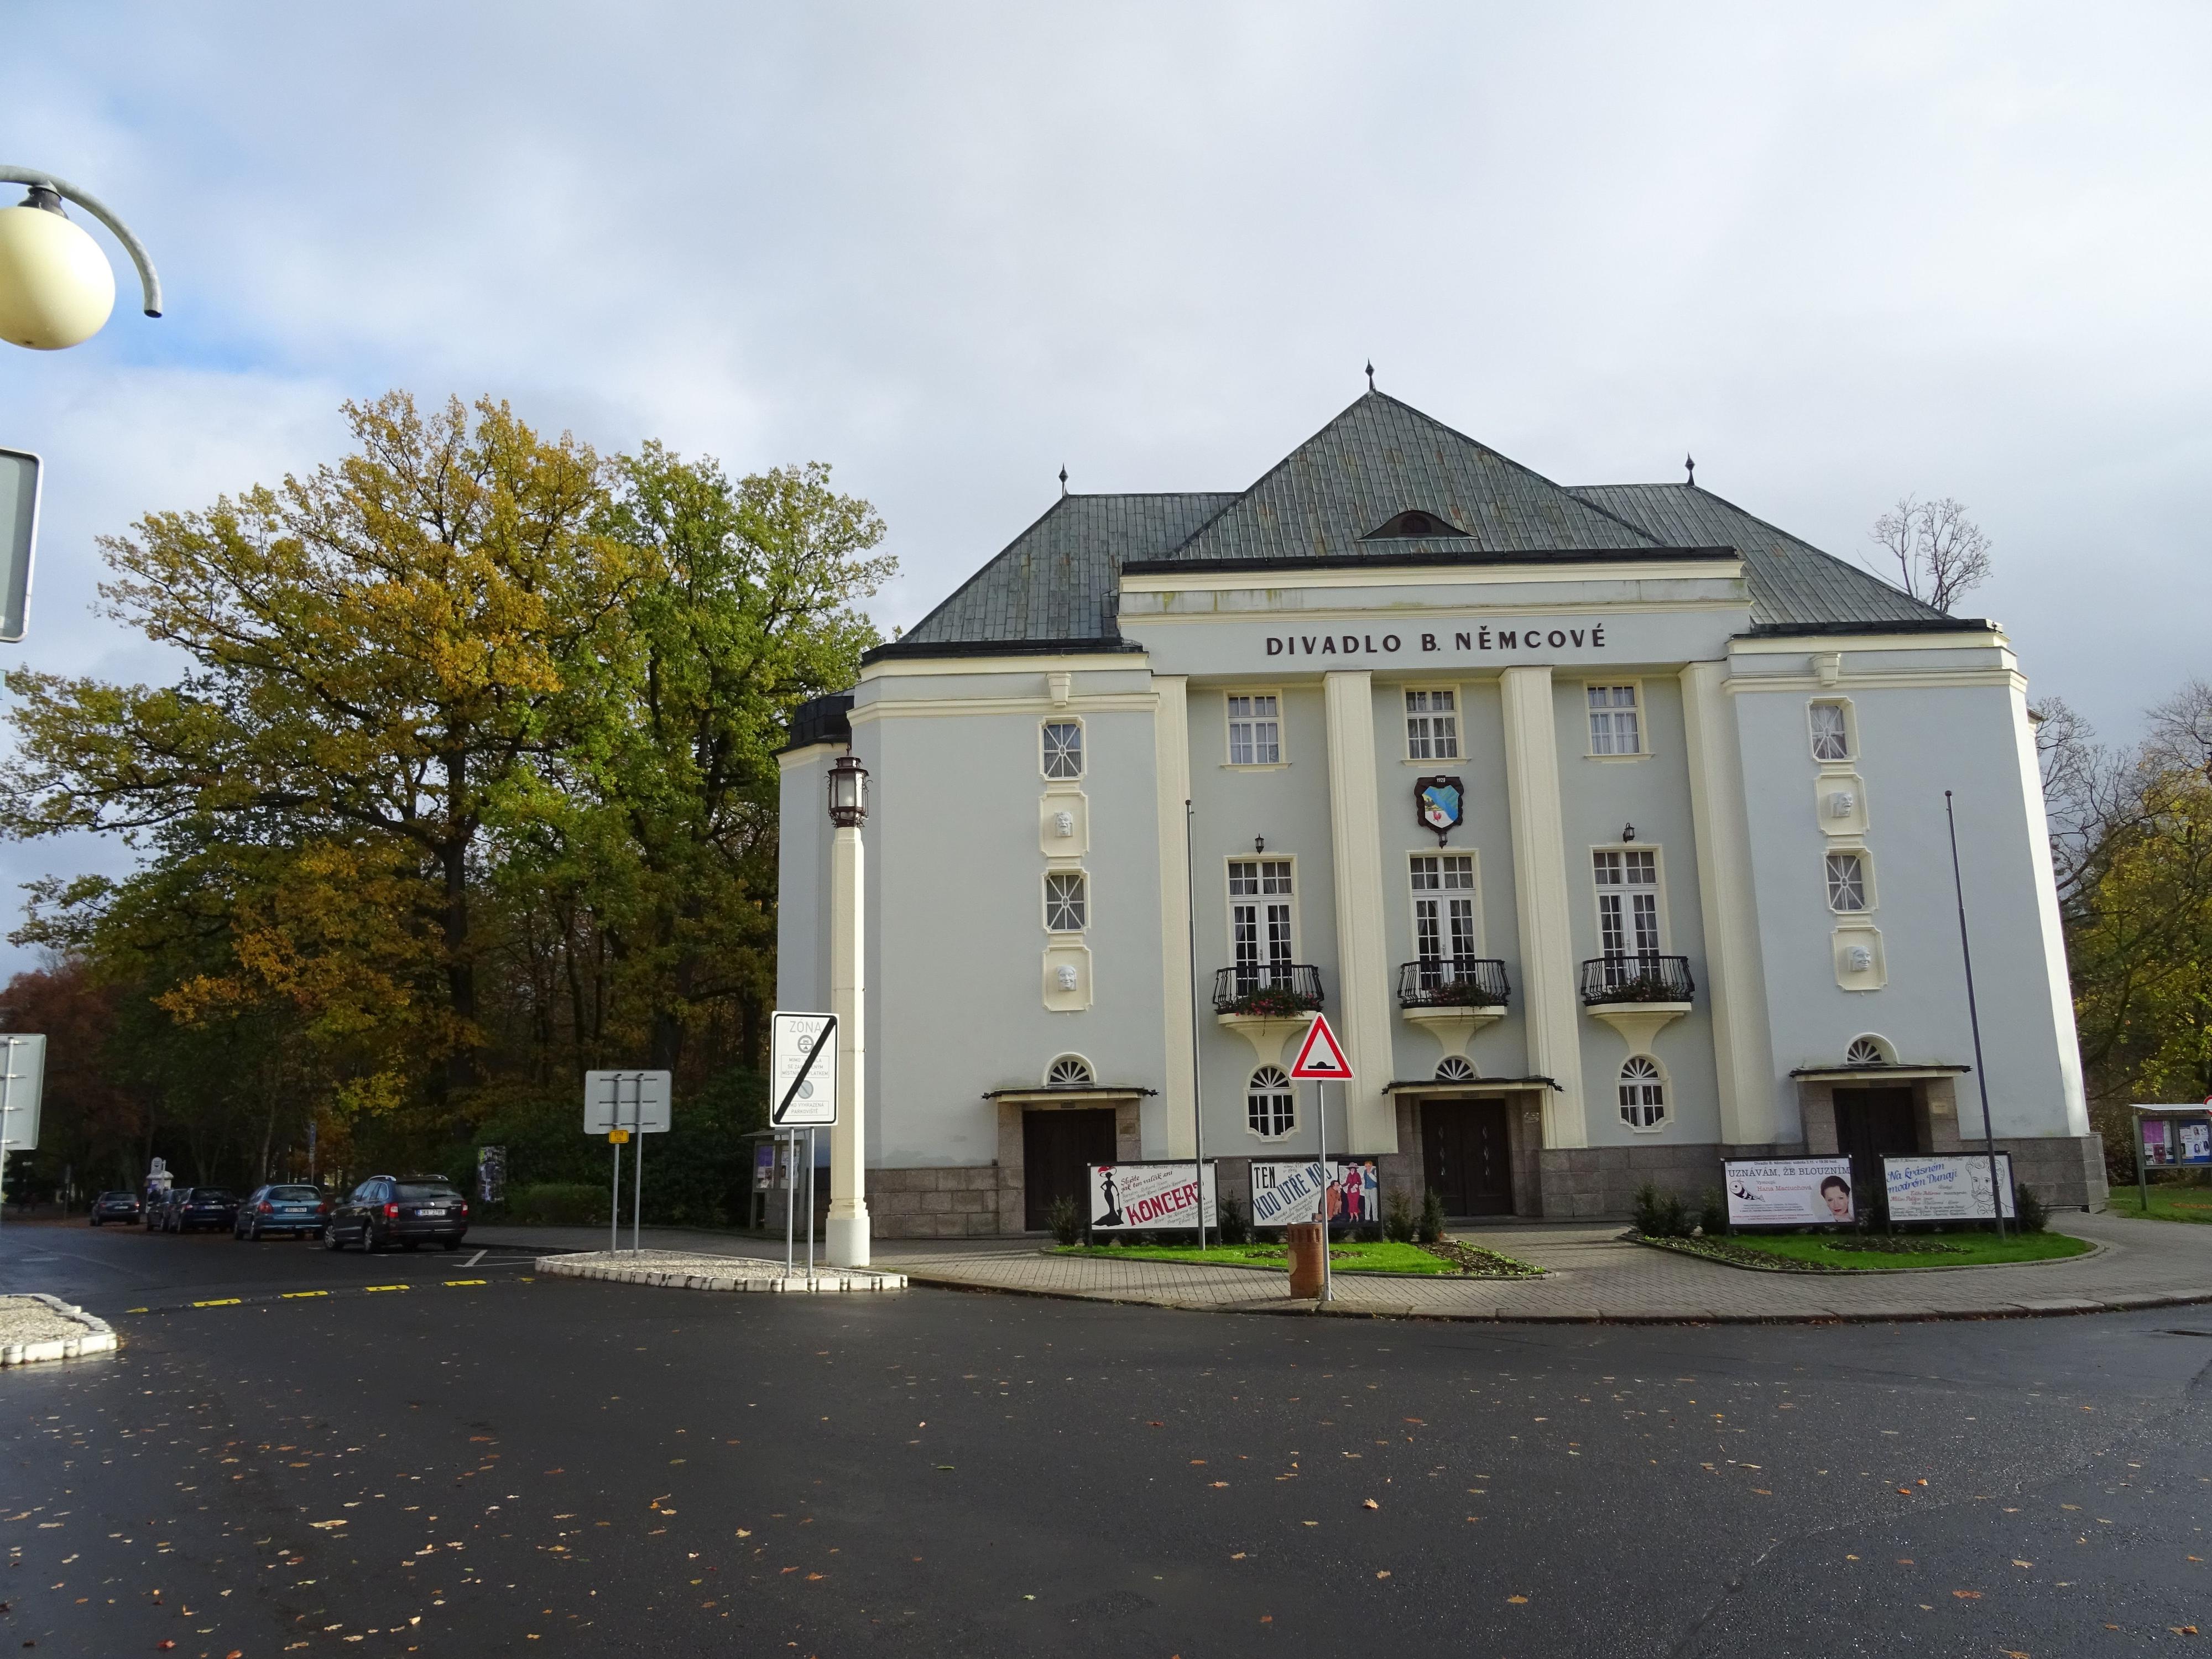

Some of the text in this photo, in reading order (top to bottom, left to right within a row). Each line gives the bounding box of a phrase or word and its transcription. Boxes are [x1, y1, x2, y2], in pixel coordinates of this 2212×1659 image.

[1266, 623, 1606, 655] DIVADLO B. NĚMCOVÉ
[789, 1019, 821, 1032] ZÓNA
[1121, 1175, 1140, 1186] Slyšte
[1254, 1166, 1276, 1188] TEN
[1728, 1165, 1850, 1177] UZNÁVÁM, ŽE BLOUZNÍM
[1886, 1162, 1945, 1183] Na krásném
[1887, 1168, 1958, 1193] modrém Dunaji
[1121, 1184, 1131, 1193] jak
[1253, 1191, 1281, 1220] KDO
[1276, 1173, 1311, 1205] UTŘE
